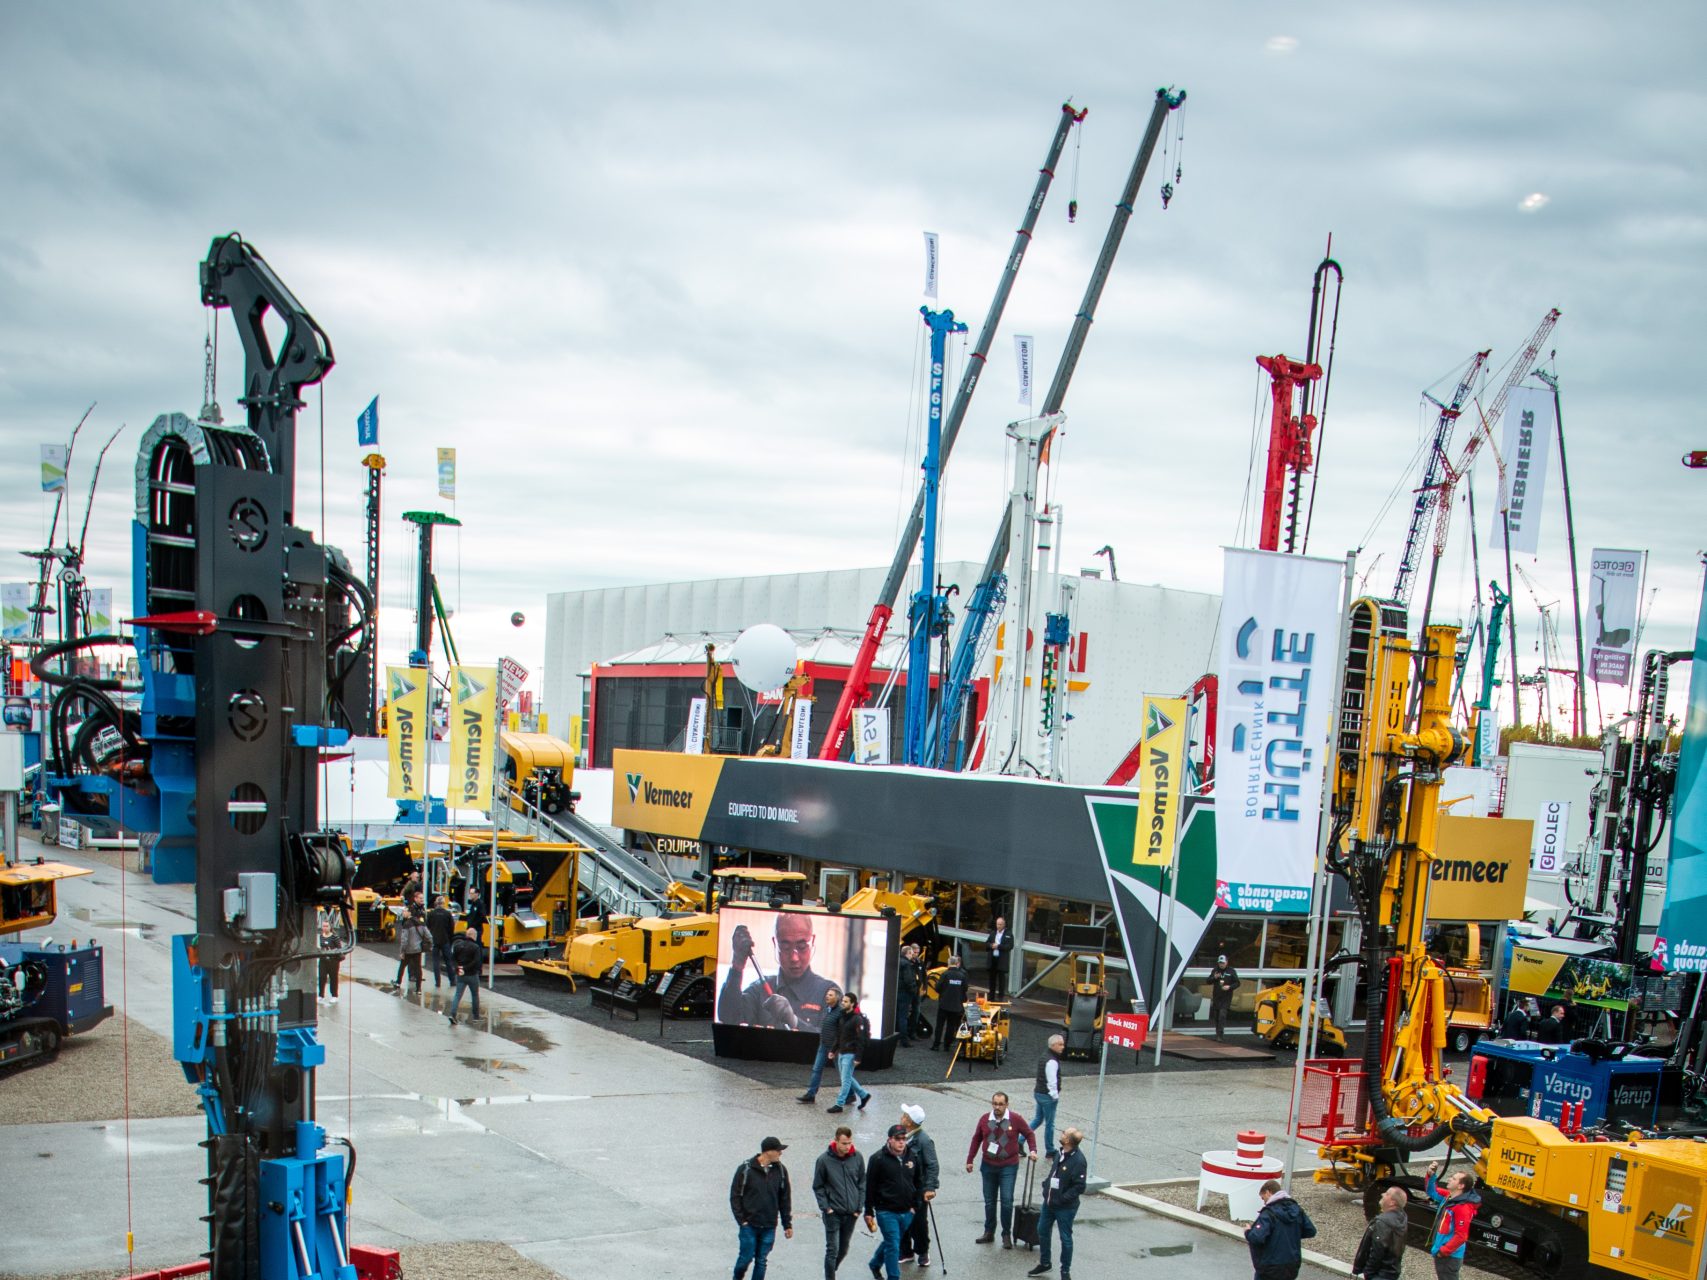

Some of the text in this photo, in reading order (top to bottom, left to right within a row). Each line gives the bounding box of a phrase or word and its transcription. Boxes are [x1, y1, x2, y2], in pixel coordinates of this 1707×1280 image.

[930, 362, 943, 420] SF65
[644, 781, 693, 809] Vermeer
[728, 802, 758, 818] EQUIPPED
[759, 806, 767, 819] TO
[767, 807, 778, 821] DO
[1431, 859, 1509, 883] ermeer
[1544, 1072, 1592, 1100] Varup
[1614, 1084, 1652, 1109] Varup
[1501, 1147, 1537, 1167] HÜTTE
